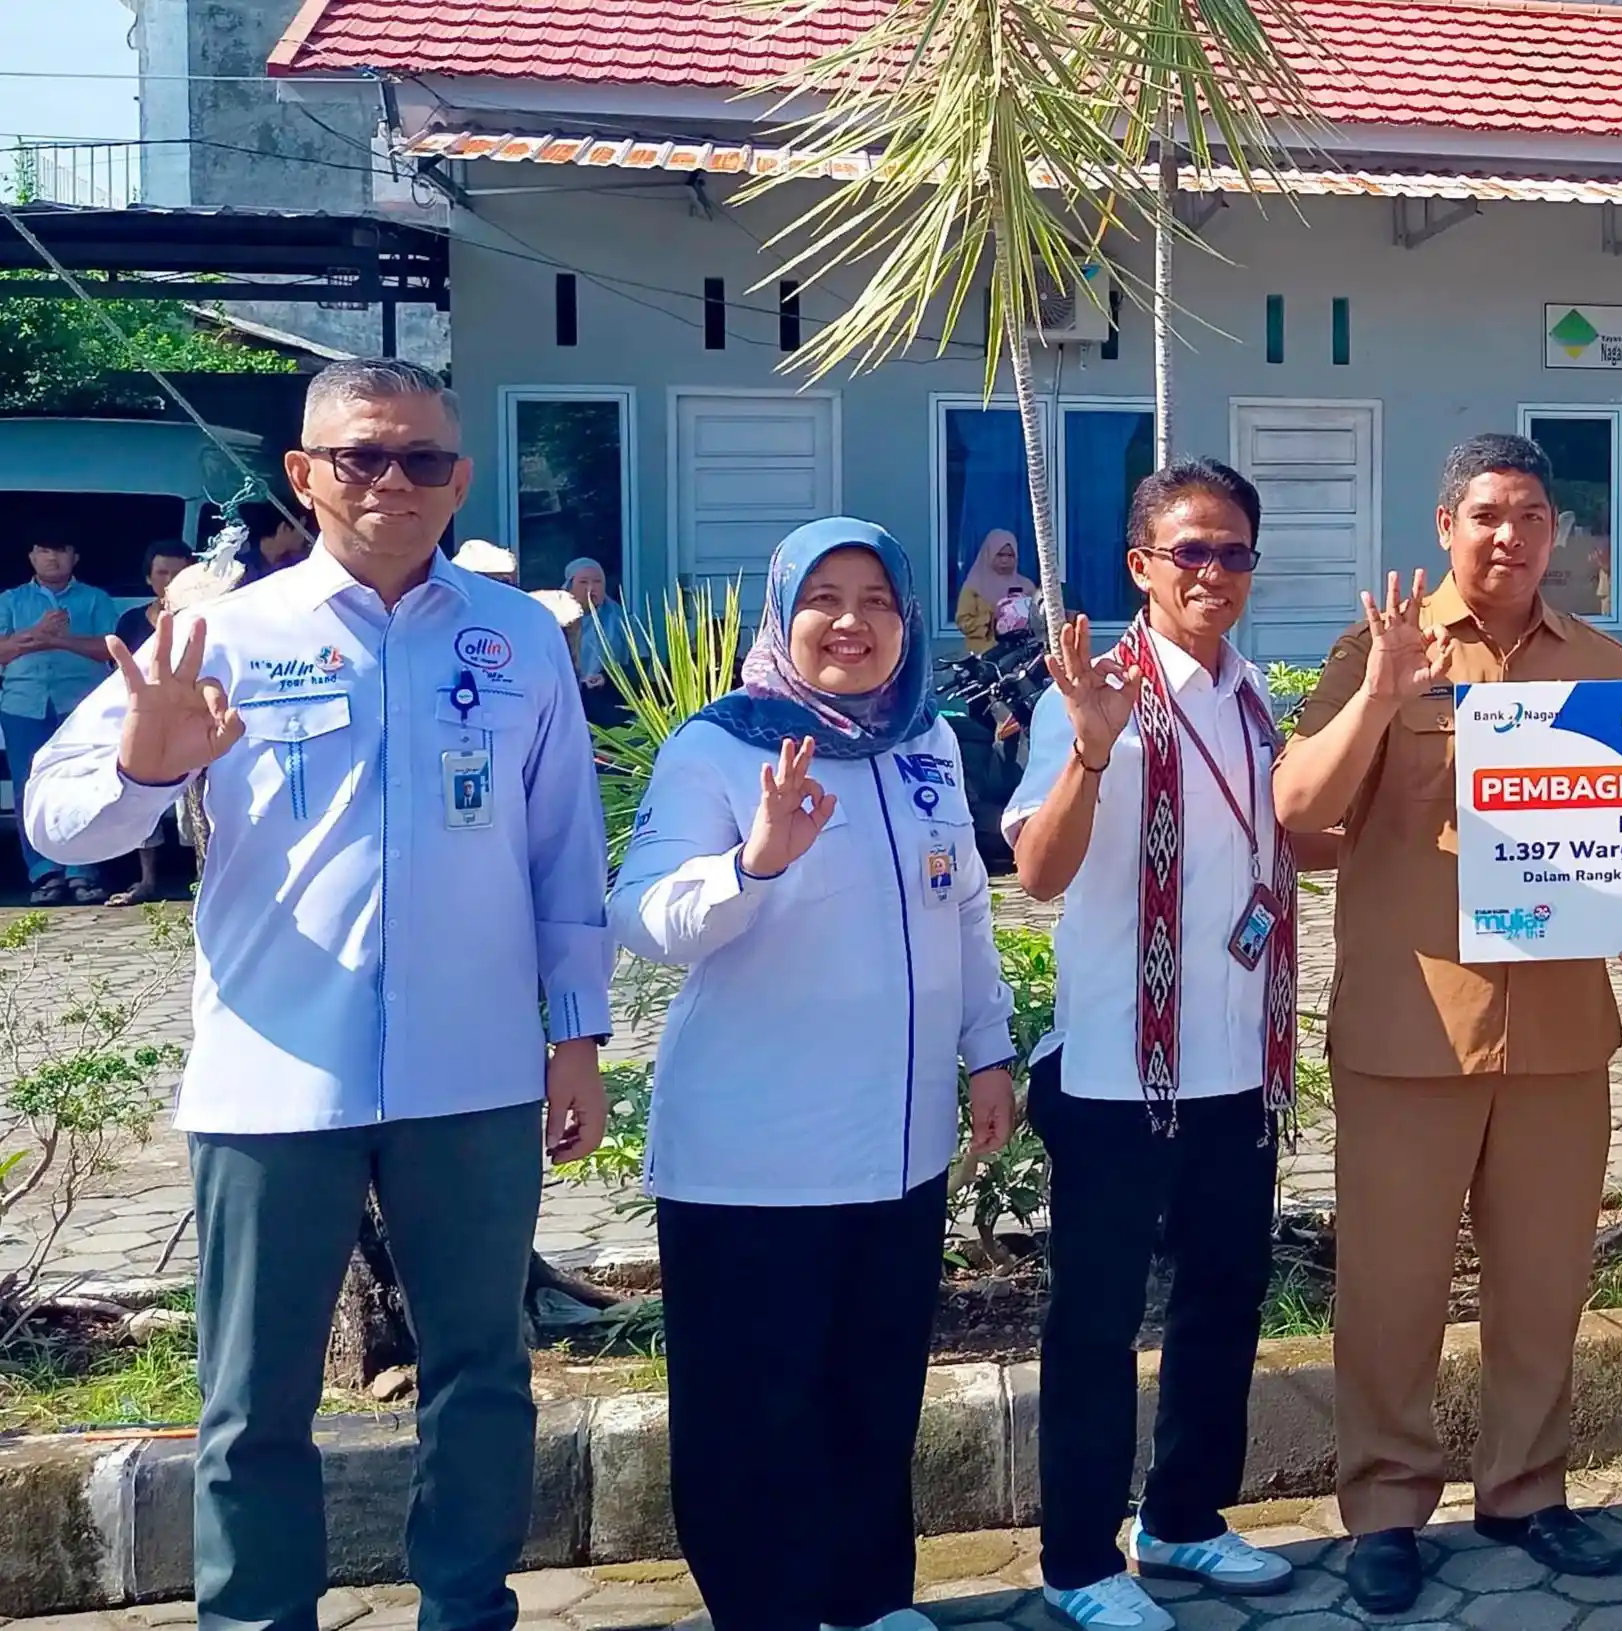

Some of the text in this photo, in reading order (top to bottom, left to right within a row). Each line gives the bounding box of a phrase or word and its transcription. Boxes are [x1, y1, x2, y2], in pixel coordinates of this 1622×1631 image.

[270, 659, 297, 680] All
[1473, 710, 1561, 722] Bank Nagar
[1494, 841, 1561, 862] 1.397
[1523, 870, 1570, 883] Dalam
